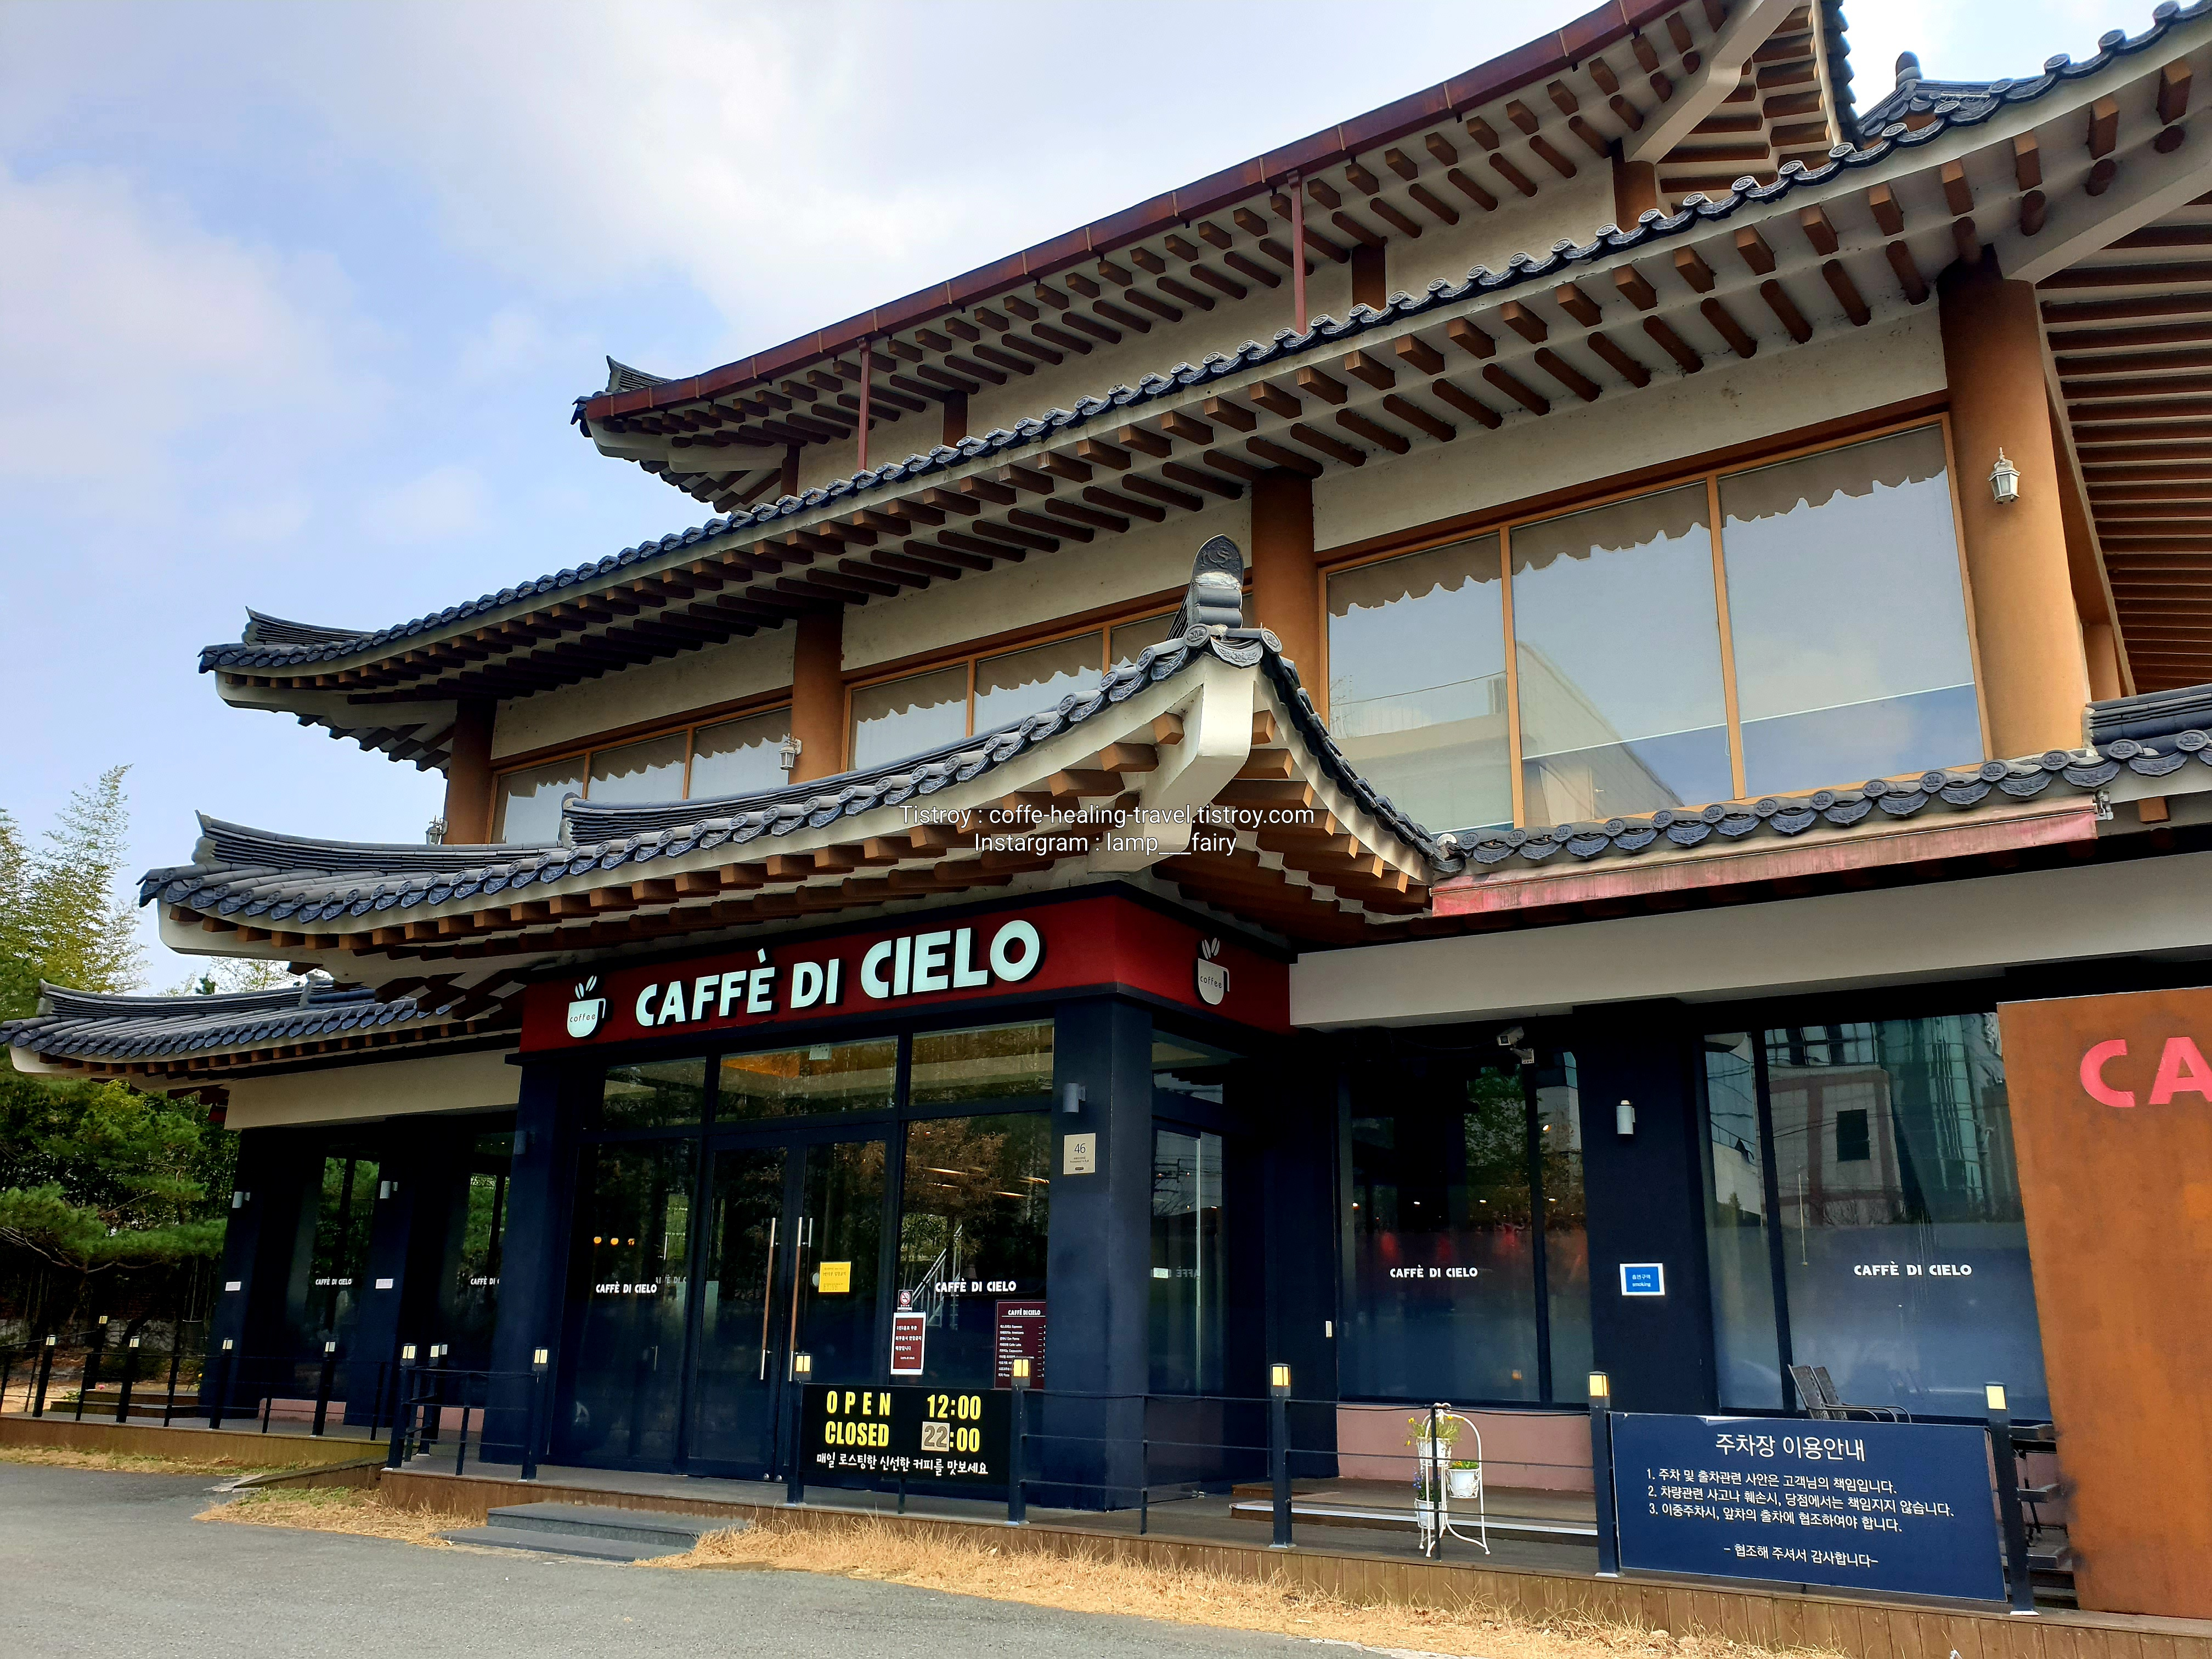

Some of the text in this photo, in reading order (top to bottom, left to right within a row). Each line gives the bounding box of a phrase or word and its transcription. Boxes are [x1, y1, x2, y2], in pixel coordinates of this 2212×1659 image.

[636, 920, 1040, 1027] CAFFÈ DI CIELO
[1200, 976, 1222, 989] coffee
[570, 1013, 596, 1023] coffee
[1074, 1143, 1086, 1153] 46
[1390, 1264, 1478, 1278] CAFFÈ DI CIELO
[1854, 1261, 1972, 1276] CAFFÈ DI CIELO
[315, 1277, 330, 1285] CAFFÈ
[470, 1276, 488, 1285] CAFFÈ
[596, 1281, 657, 1293] CAFFÈ DI CIELO
[935, 1278, 1017, 1292] CAFFÈ DI CIELO
[927, 1395, 981, 1420] 12:00
[825, 1421, 980, 1452] CLOSED 22:00
[1716, 1434, 1865, 1462] 주차장 이용안내
[817, 1452, 989, 1476] 매일 로스팅한 신선한 커피를 맛보세요
[1647, 1469, 1897, 1494] 1. 주차 및 출차관련 사안은 고객님의 책임입니다.
[1647, 1486, 1954, 1517] 2. 차량관련 사고나 훼손시, 당점에서는 책임지지 않습니다.
[1649, 1503, 1903, 1532] 3. 이중주차시, 앞차의 출차에 협조하여야 합니다.
[1734, 1543, 1769, 1559] 협조해
[1772, 1547, 1807, 1562] 주셔서
